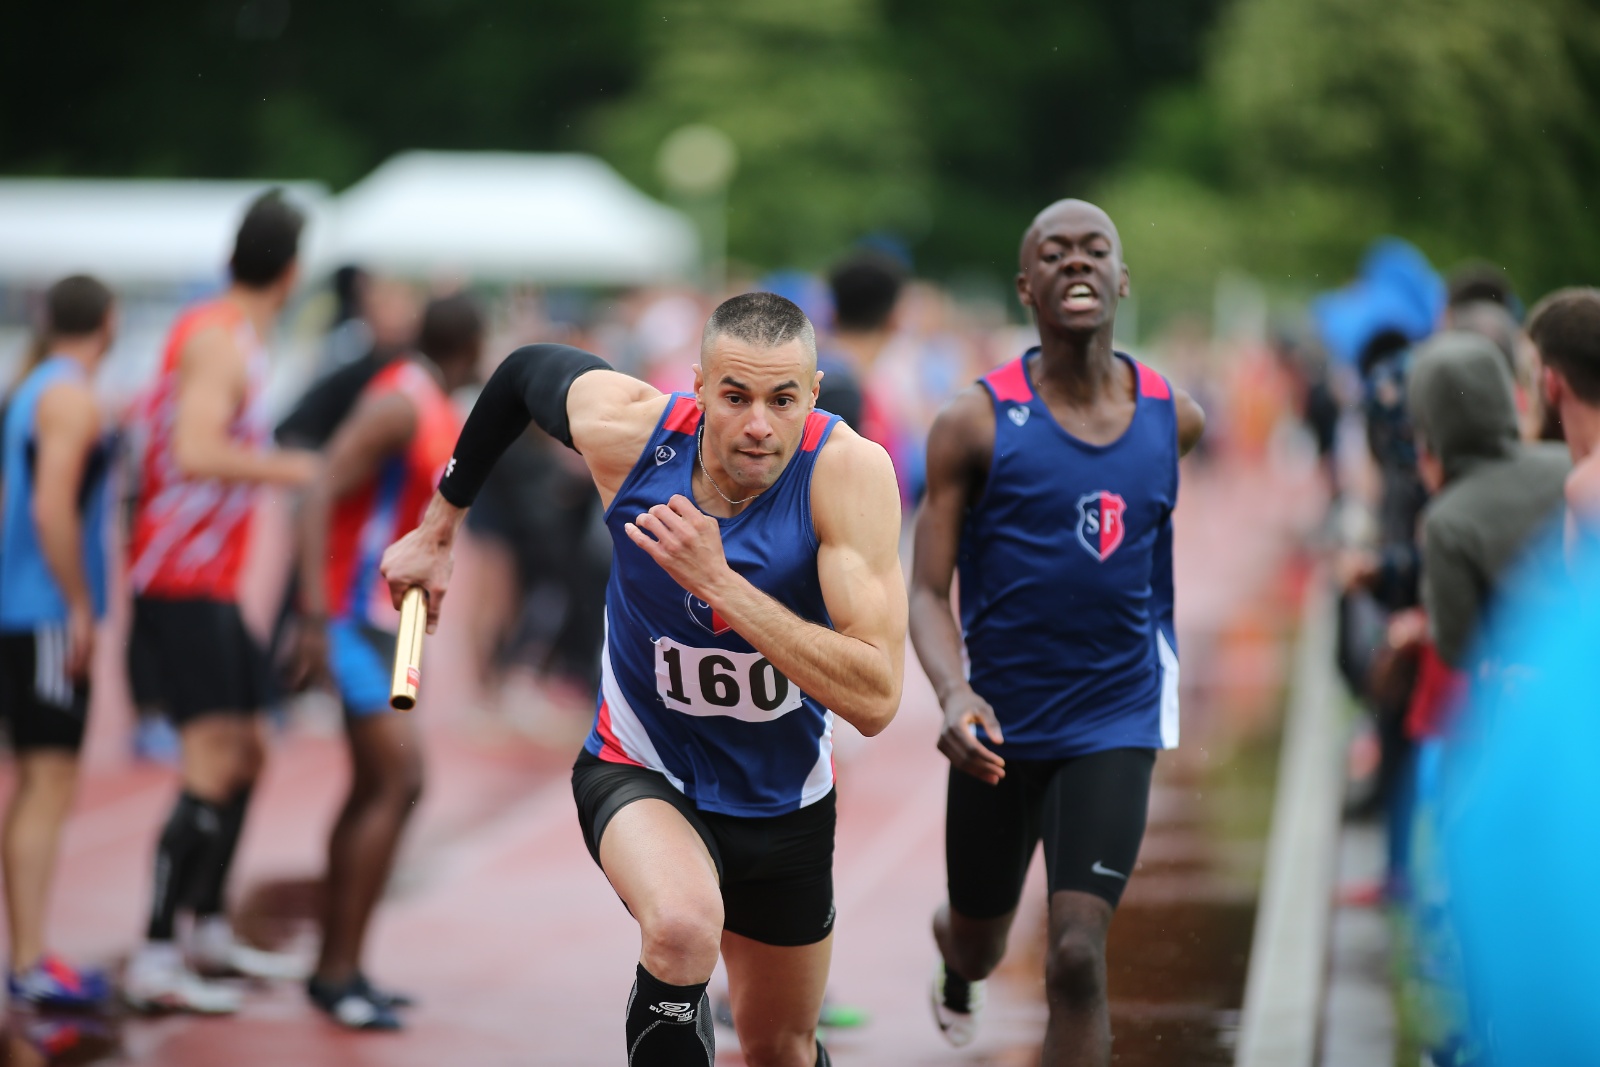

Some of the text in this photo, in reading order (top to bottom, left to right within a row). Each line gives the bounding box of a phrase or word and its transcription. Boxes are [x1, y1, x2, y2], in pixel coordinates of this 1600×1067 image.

[1085, 508, 1117, 535] SF
[663, 646, 789, 711] 160
[663, 1009, 695, 1018] SPORT
